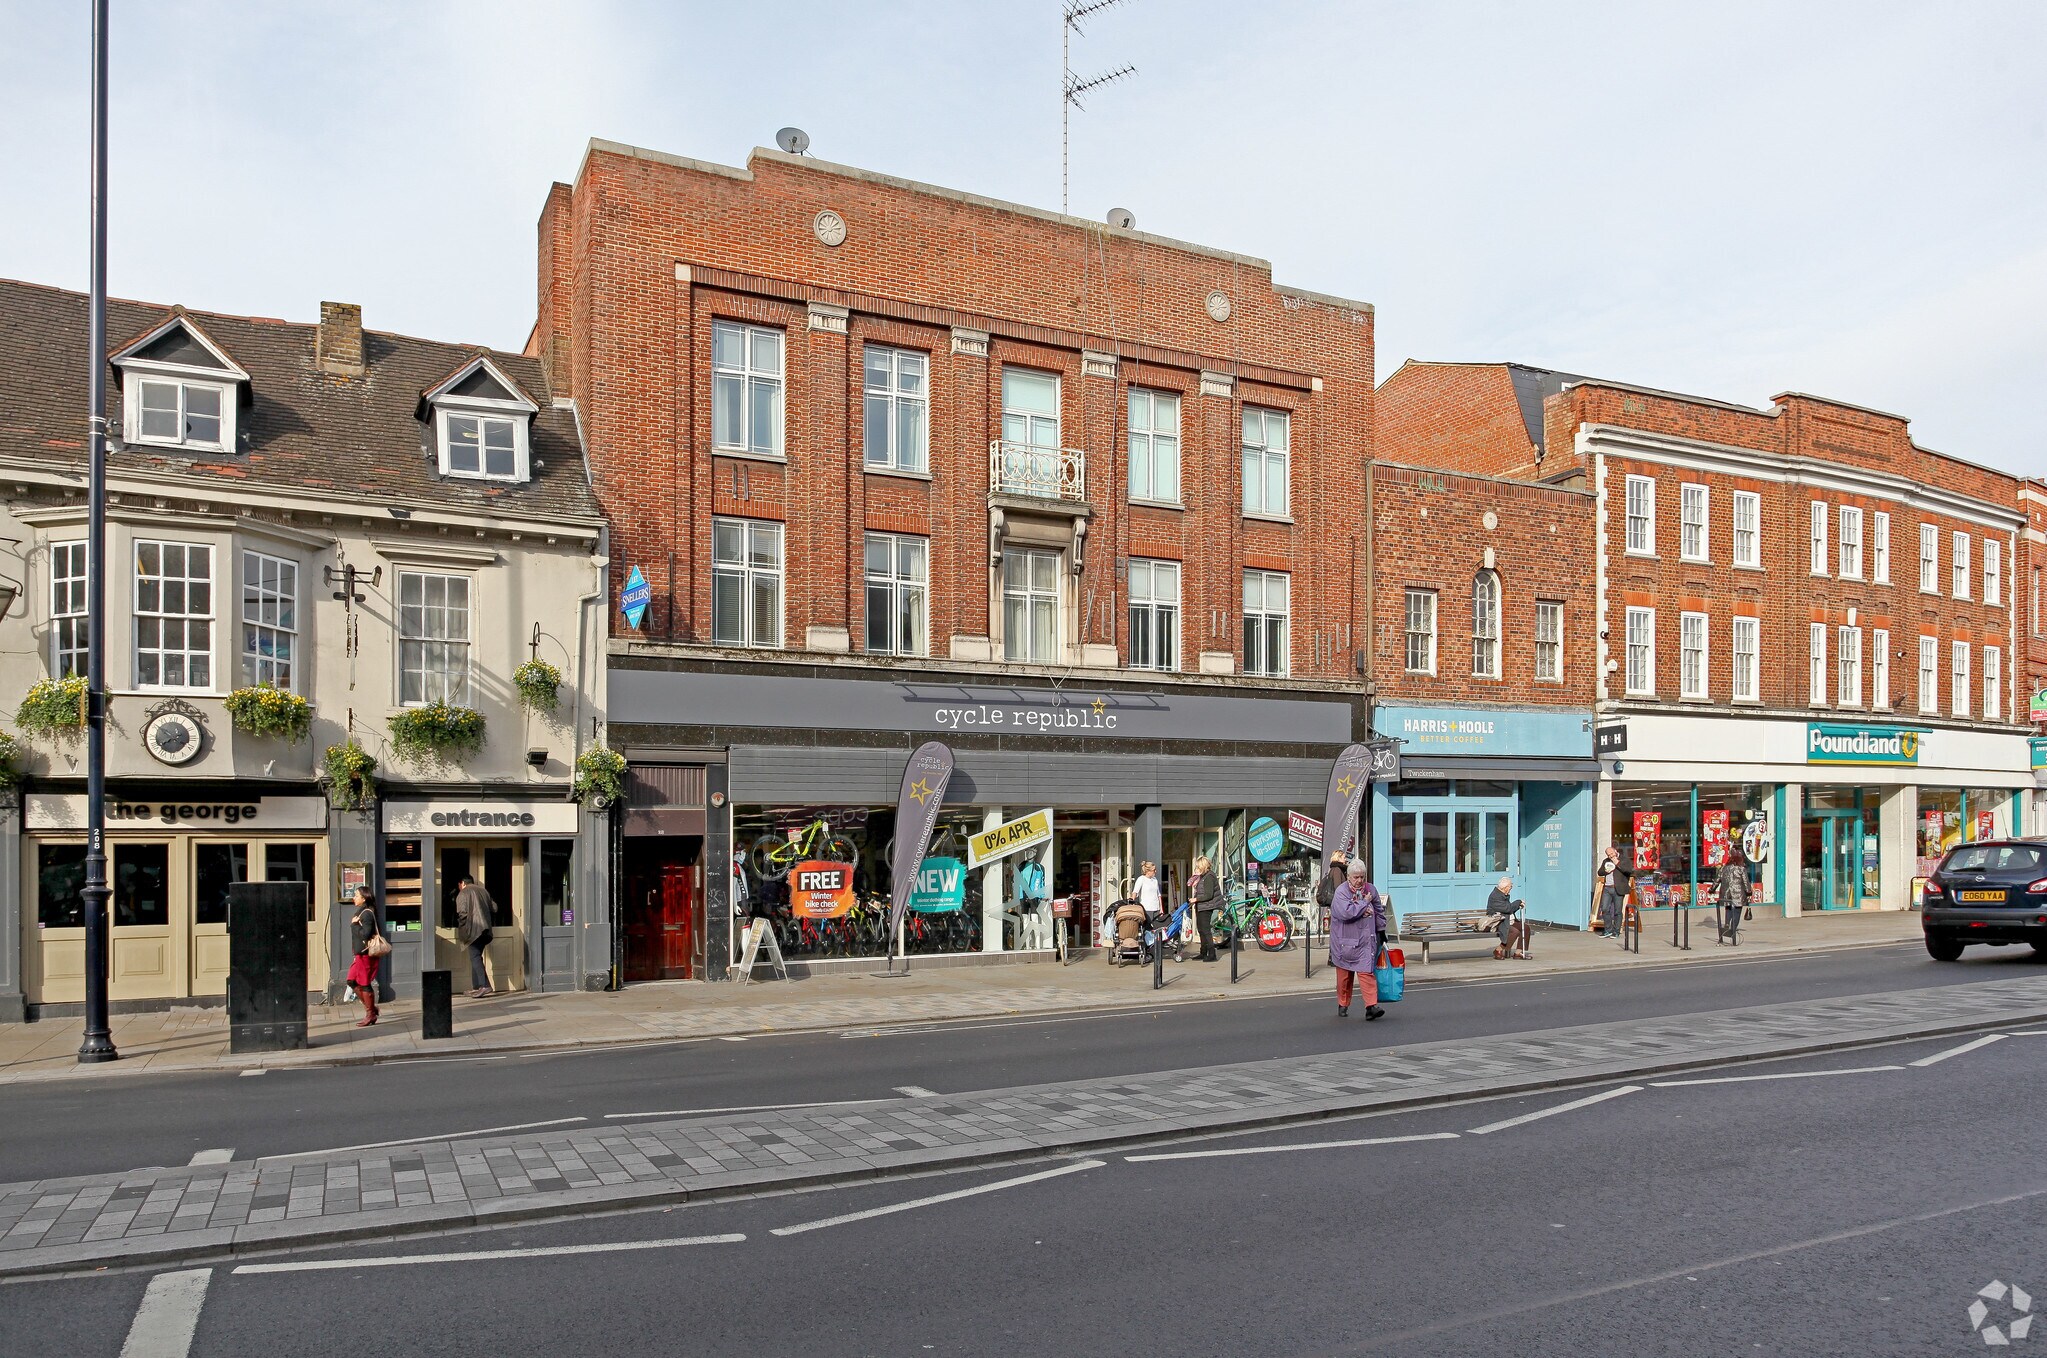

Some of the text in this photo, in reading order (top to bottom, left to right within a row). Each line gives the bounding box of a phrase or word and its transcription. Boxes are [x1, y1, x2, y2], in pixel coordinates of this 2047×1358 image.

[631, 575, 639, 584] LET
[622, 587, 649, 608] SNELLERS
[935, 706, 1117, 731] cycle republic
[1420, 735, 1484, 744] BETTER COFFEE
[1810, 728, 1900, 755] Poundland
[1407, 769, 1446, 778] Twickenham
[160, 804, 257, 824] george
[431, 809, 536, 827] entrance
[907, 788, 942, 883] www.cyclerepublic.com
[984, 820, 1033, 850] 0% APR
[1291, 816, 1306, 832] TAX
[1305, 822, 1323, 839] FREE
[1250, 827, 1281, 849] workshop
[1255, 838, 1281, 857] in-store
[800, 871, 841, 891] FREE
[913, 868, 959, 894] NEW
[805, 900, 839, 908] bike check
[811, 892, 833, 900] Winter
[1987, 892, 2004, 900] YAA
[1262, 919, 1281, 930] SALE
[1262, 932, 1283, 941] NOW ON
